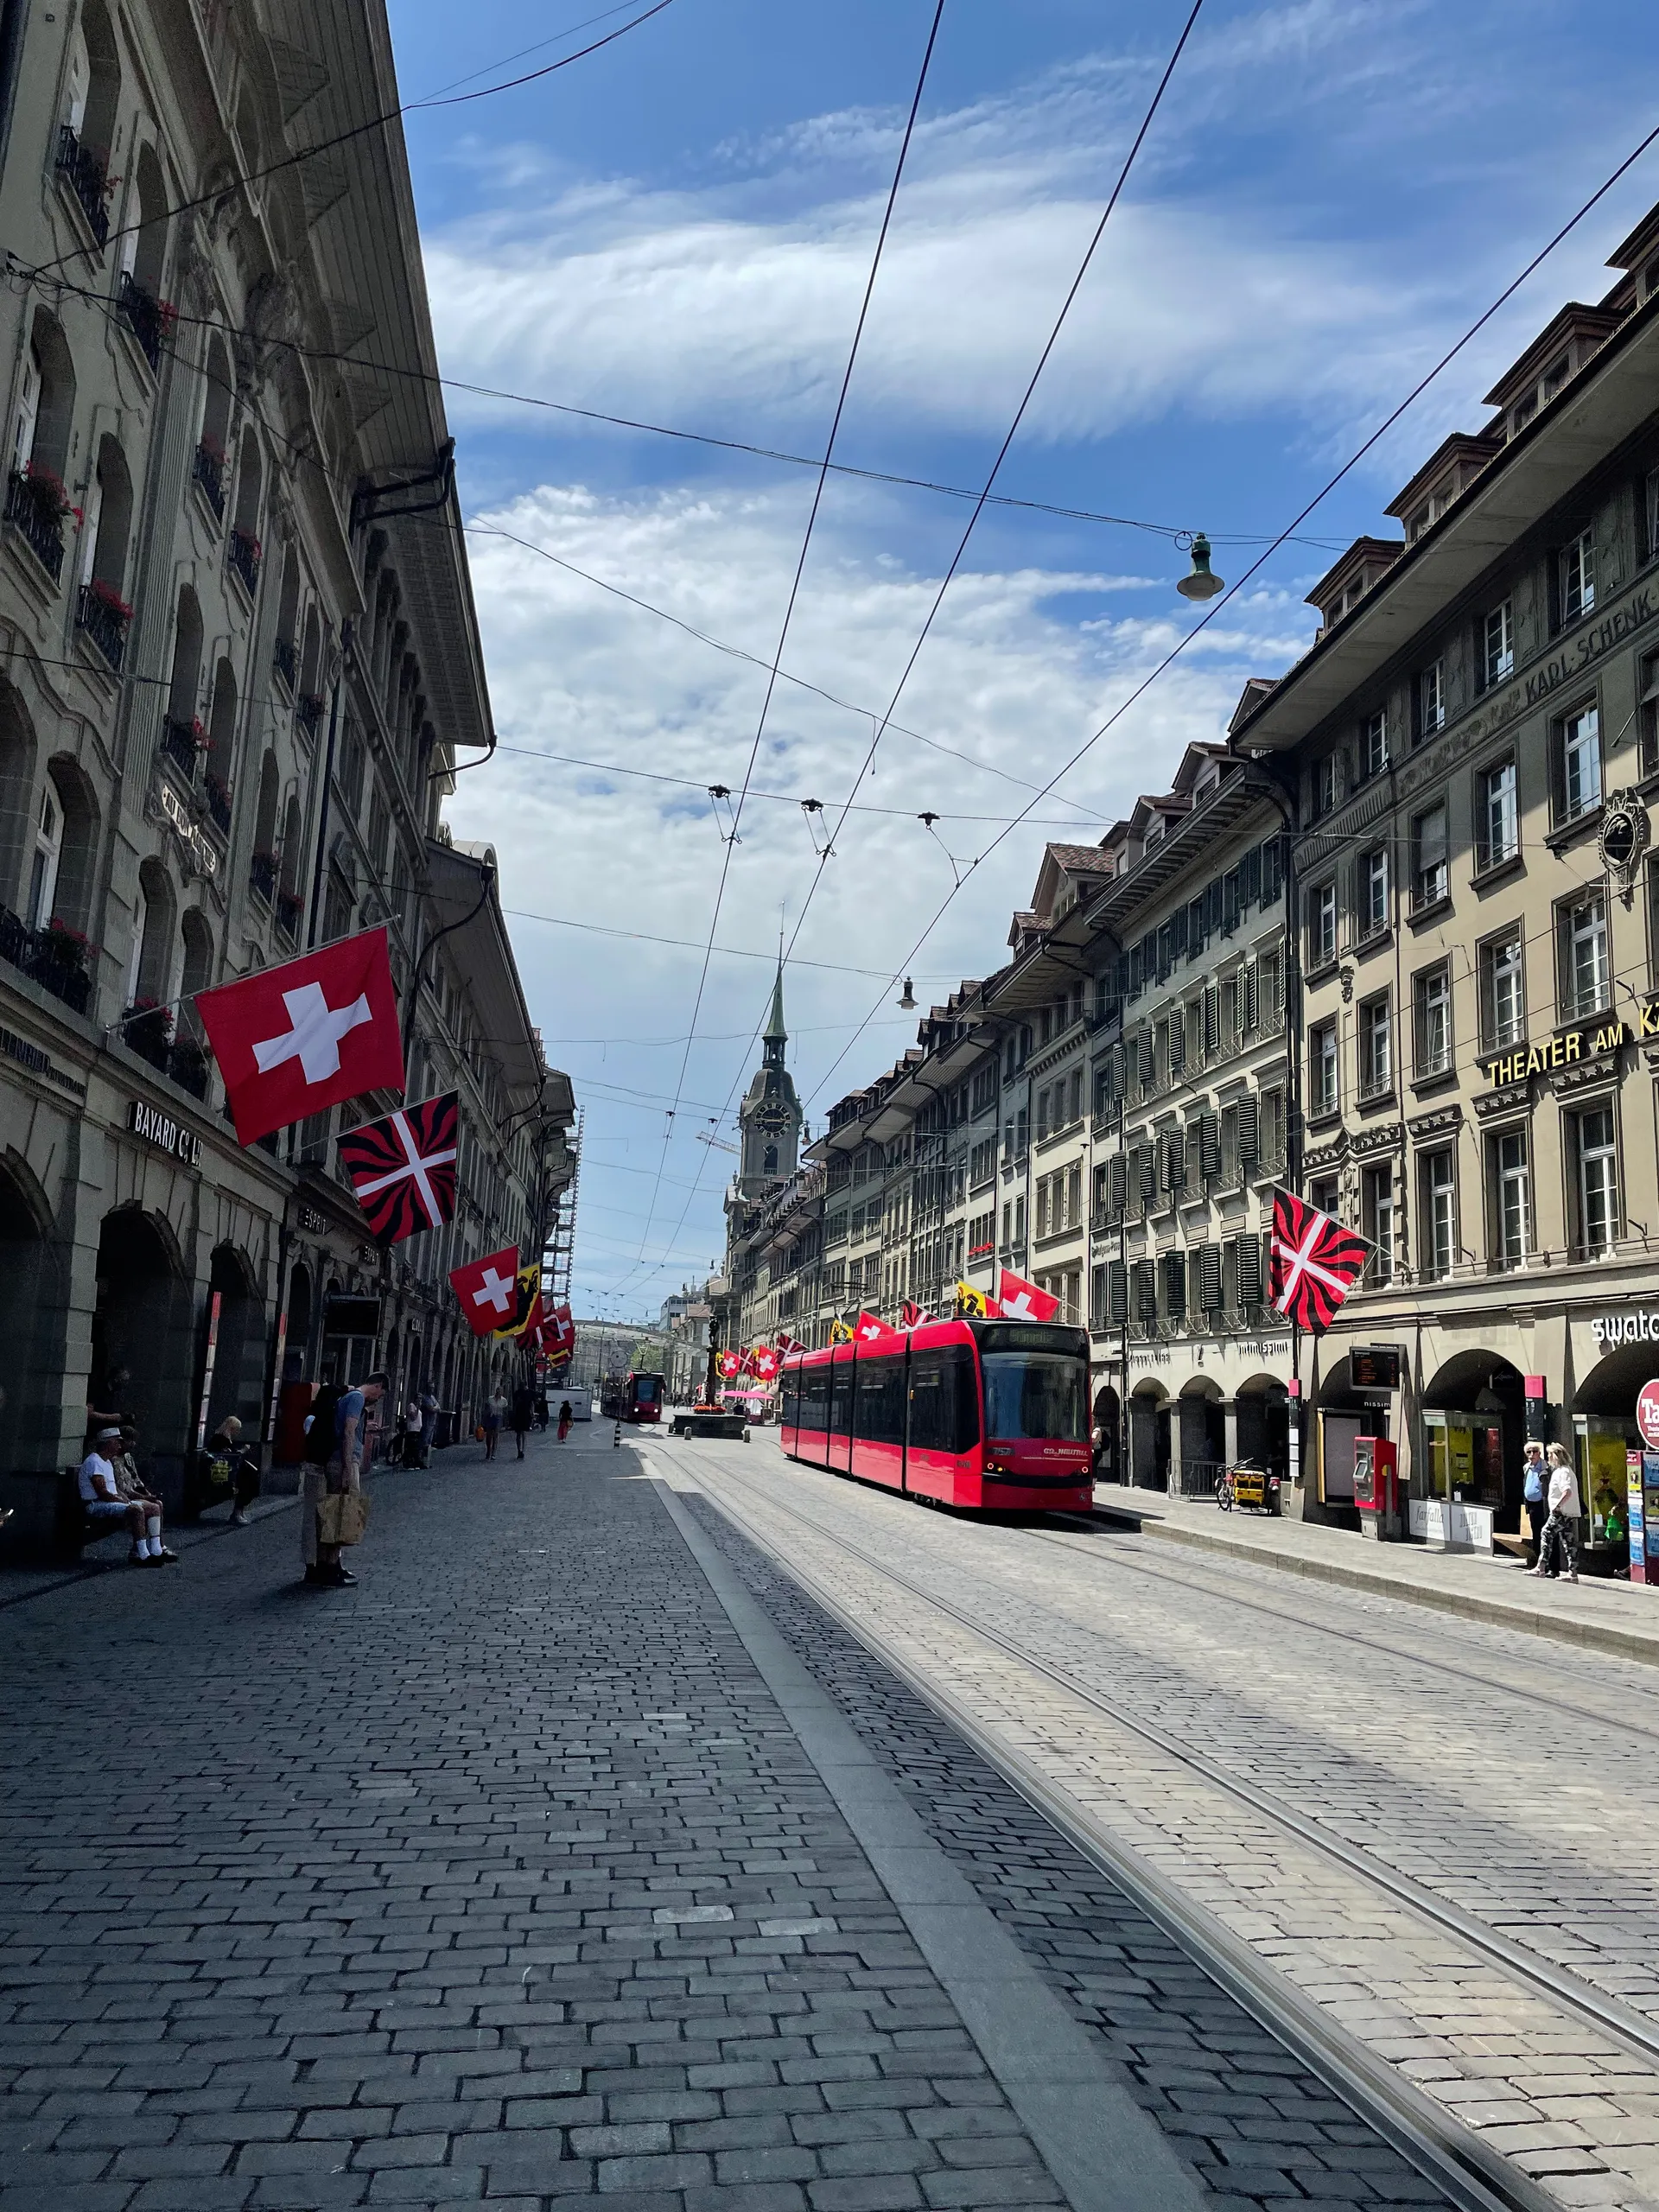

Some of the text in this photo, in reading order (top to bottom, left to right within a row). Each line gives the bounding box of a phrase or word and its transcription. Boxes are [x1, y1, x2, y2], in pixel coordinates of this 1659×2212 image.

[1525, 652, 1573, 703] KARL
[1487, 1032, 1580, 1088] THEATER
[1595, 1023, 1624, 1052] AM
[135, 1101, 177, 1153] BAYARD
[304, 1208, 327, 1235] ESPRIT
[1414, 1505, 1445, 1526] farfalla
